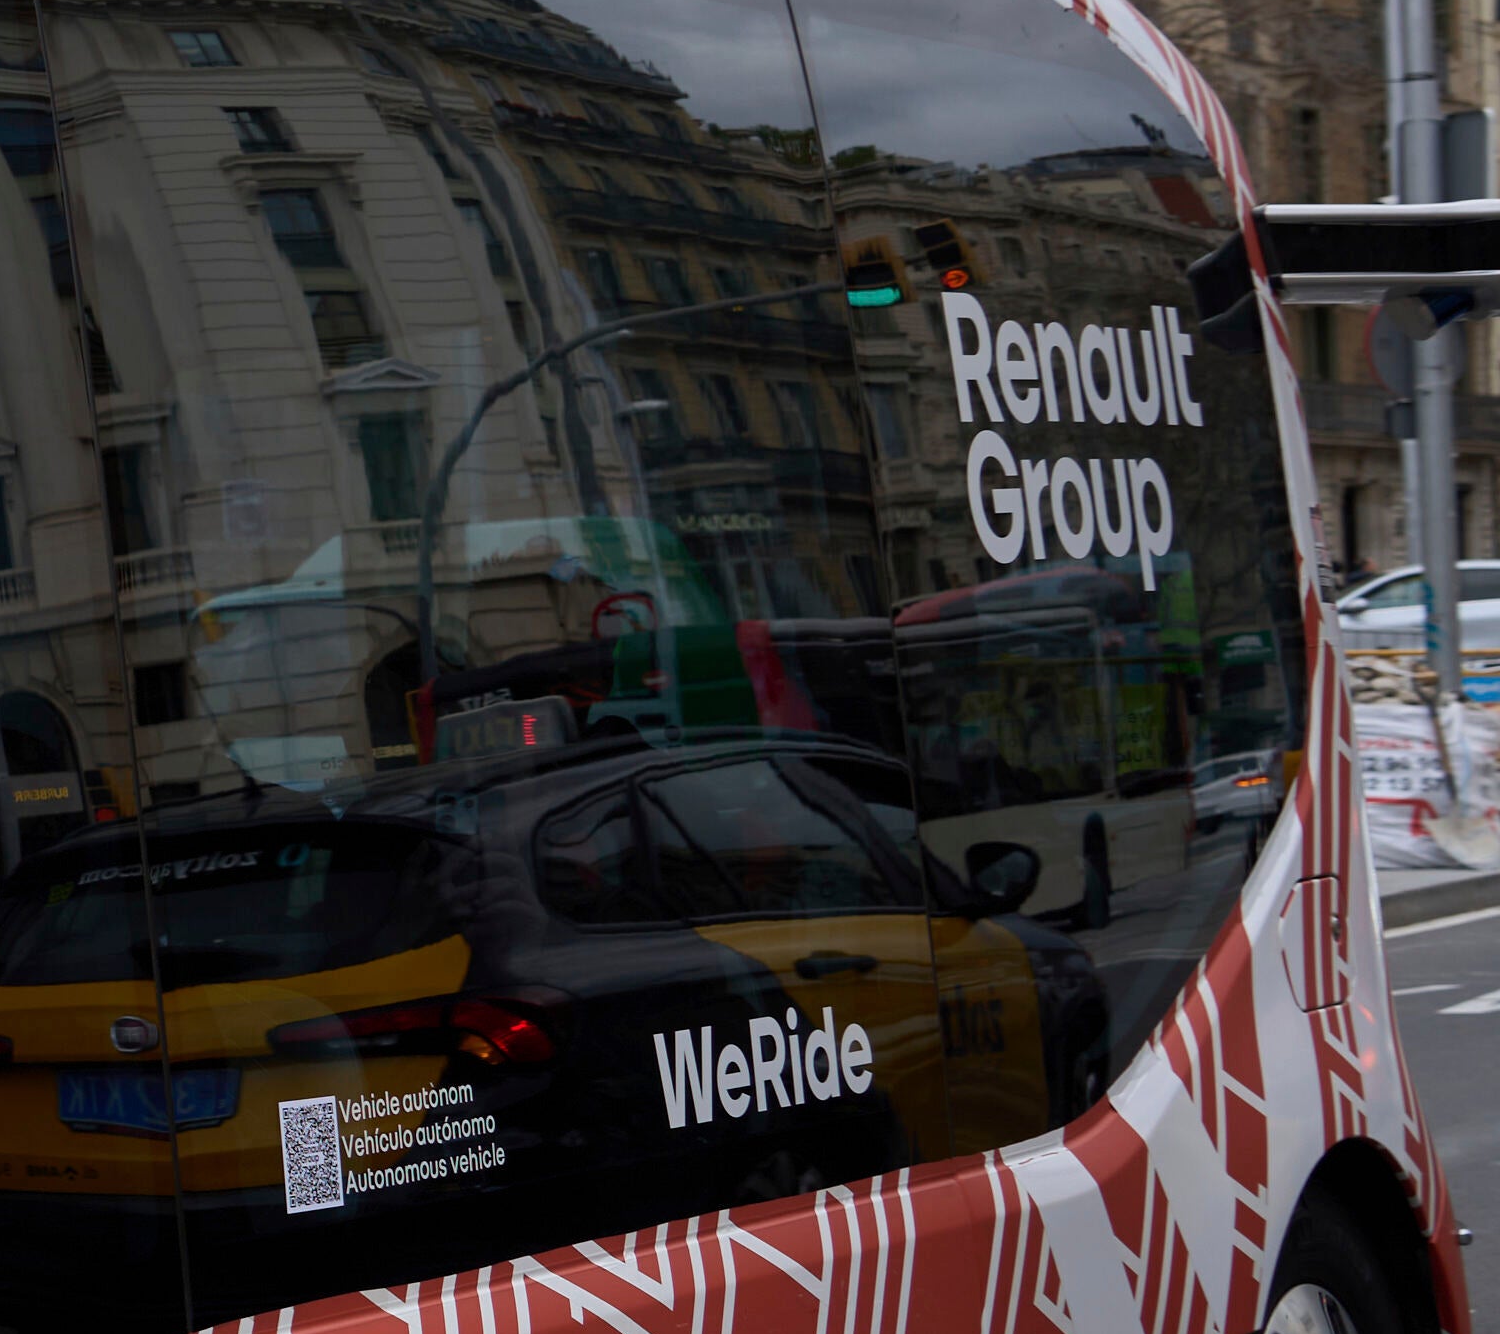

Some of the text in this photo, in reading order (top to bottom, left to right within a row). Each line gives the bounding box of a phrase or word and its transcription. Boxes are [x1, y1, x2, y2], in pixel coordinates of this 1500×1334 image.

[941, 291, 1204, 427] Renault
[966, 429, 1174, 592] Group
[339, 1082, 474, 1123] Vehicle autònom
[653, 1005, 875, 1130] WeRide
[342, 1114, 496, 1159] Vehículo autónomo
[346, 1142, 506, 1195] Autonomous vehicle
